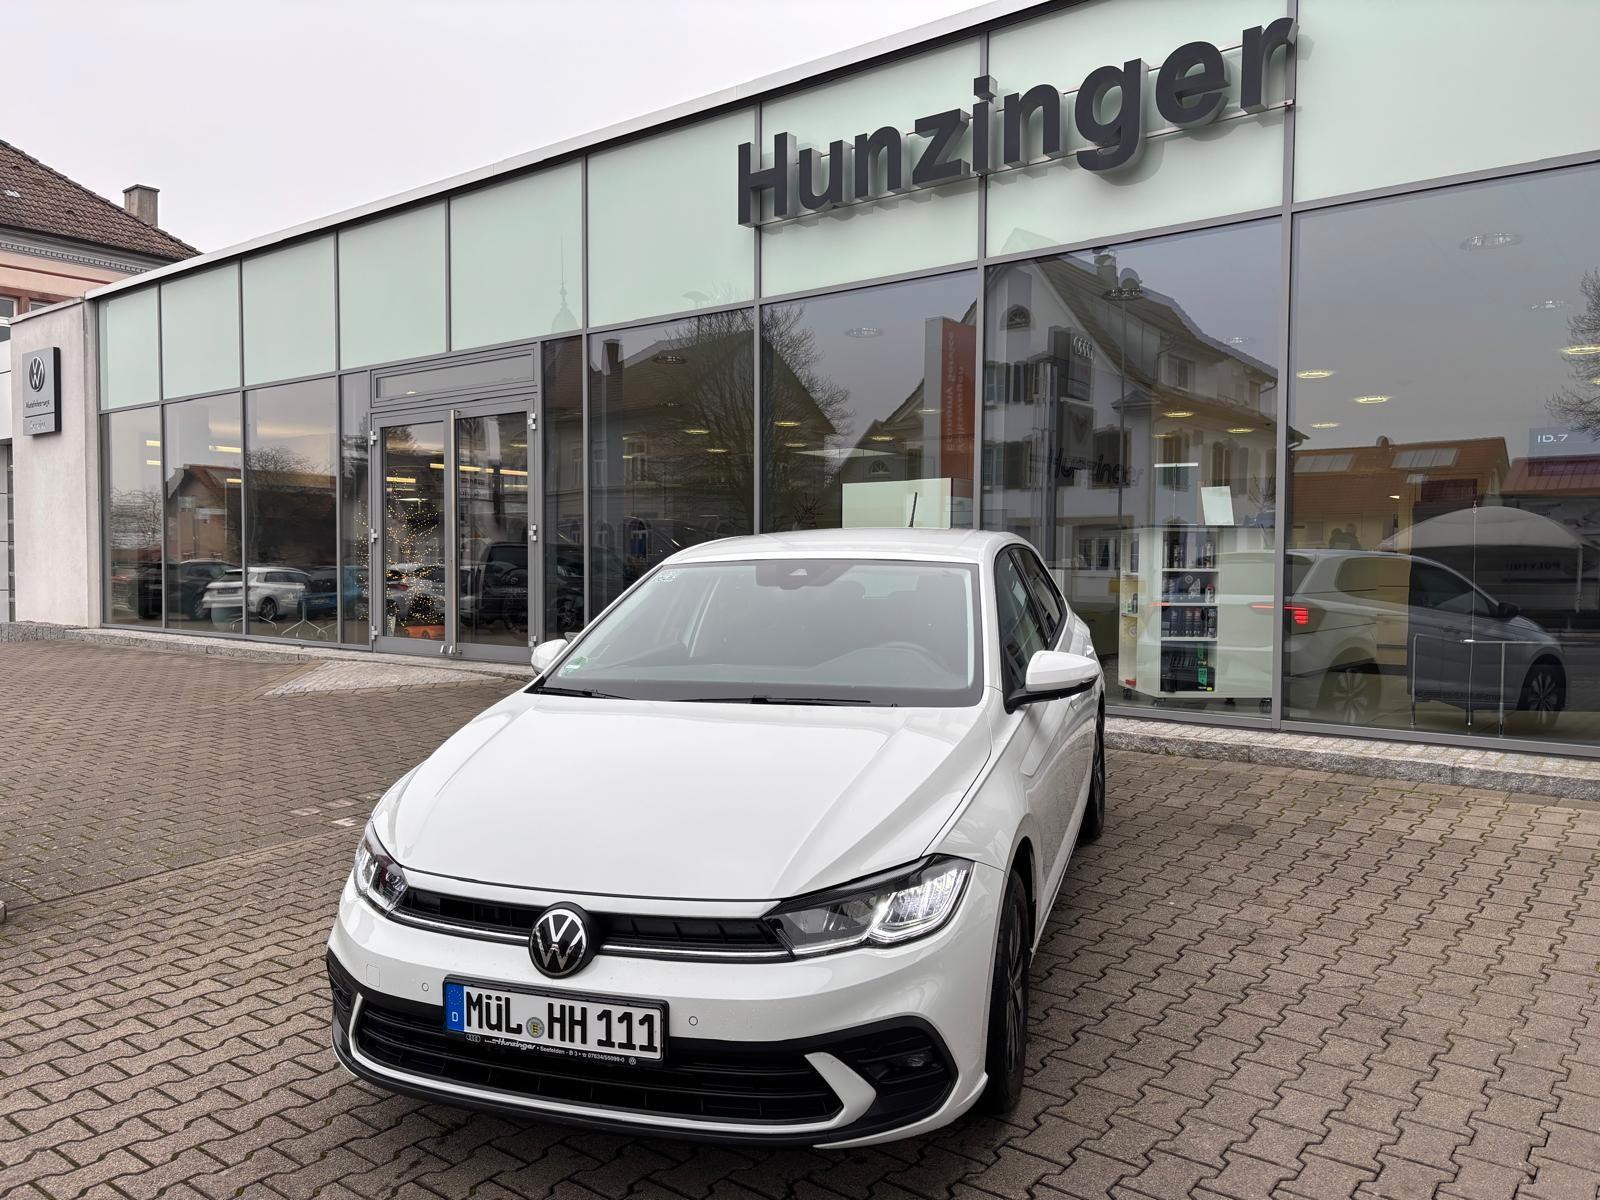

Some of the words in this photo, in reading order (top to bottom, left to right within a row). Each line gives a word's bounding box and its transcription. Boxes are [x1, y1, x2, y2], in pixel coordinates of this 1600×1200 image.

[738, 17, 1298, 226] Hunzinger
[1537, 433, 1568, 443] ID.7
[452, 1011, 459, 1022] D
[547, 1002, 588, 1045] HH
[596, 1009, 658, 1053] 111
[498, 1038, 536, 1051] Hunzinger
[540, 1045, 565, 1055] Seefelden
